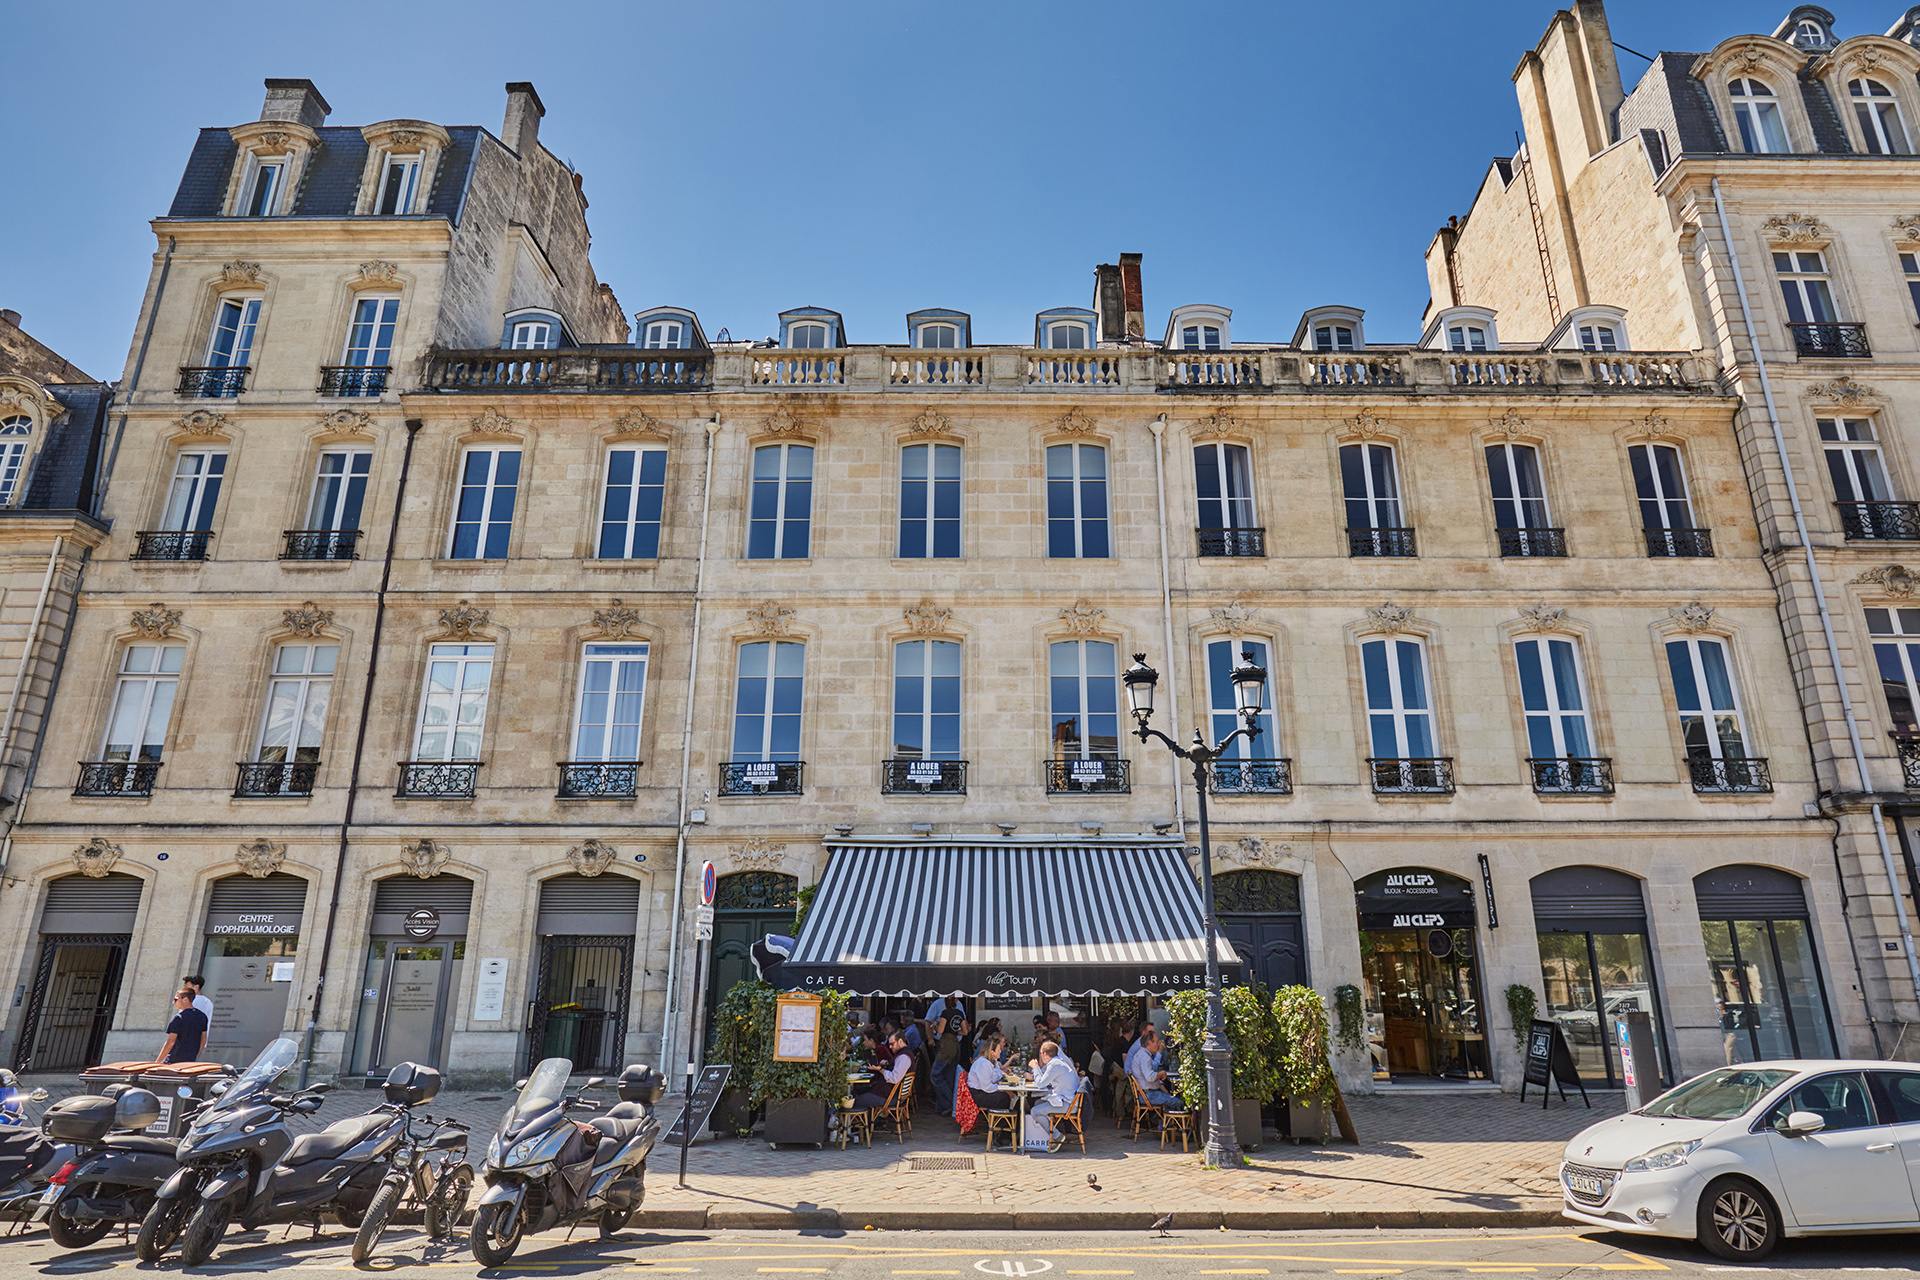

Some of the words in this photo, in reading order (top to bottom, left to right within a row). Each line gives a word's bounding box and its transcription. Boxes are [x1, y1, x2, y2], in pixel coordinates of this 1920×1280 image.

[746, 763, 752, 771] A
[753, 763, 776, 771] LOUER
[910, 762, 916, 770] A
[917, 762, 939, 770] LOUER
[1073, 761, 1079, 769] A
[1080, 761, 1102, 769] LOUER
[1386, 874, 1403, 886] AU
[238, 914, 274, 923] CENTRE
[1393, 914, 1411, 927] AU
[214, 925, 295, 934] D'OPHTALMOLOGIE
[806, 975, 846, 985] CAFE
[1008, 974, 1038, 986] Tourny
[1139, 974, 1230, 985] BRASSEE
